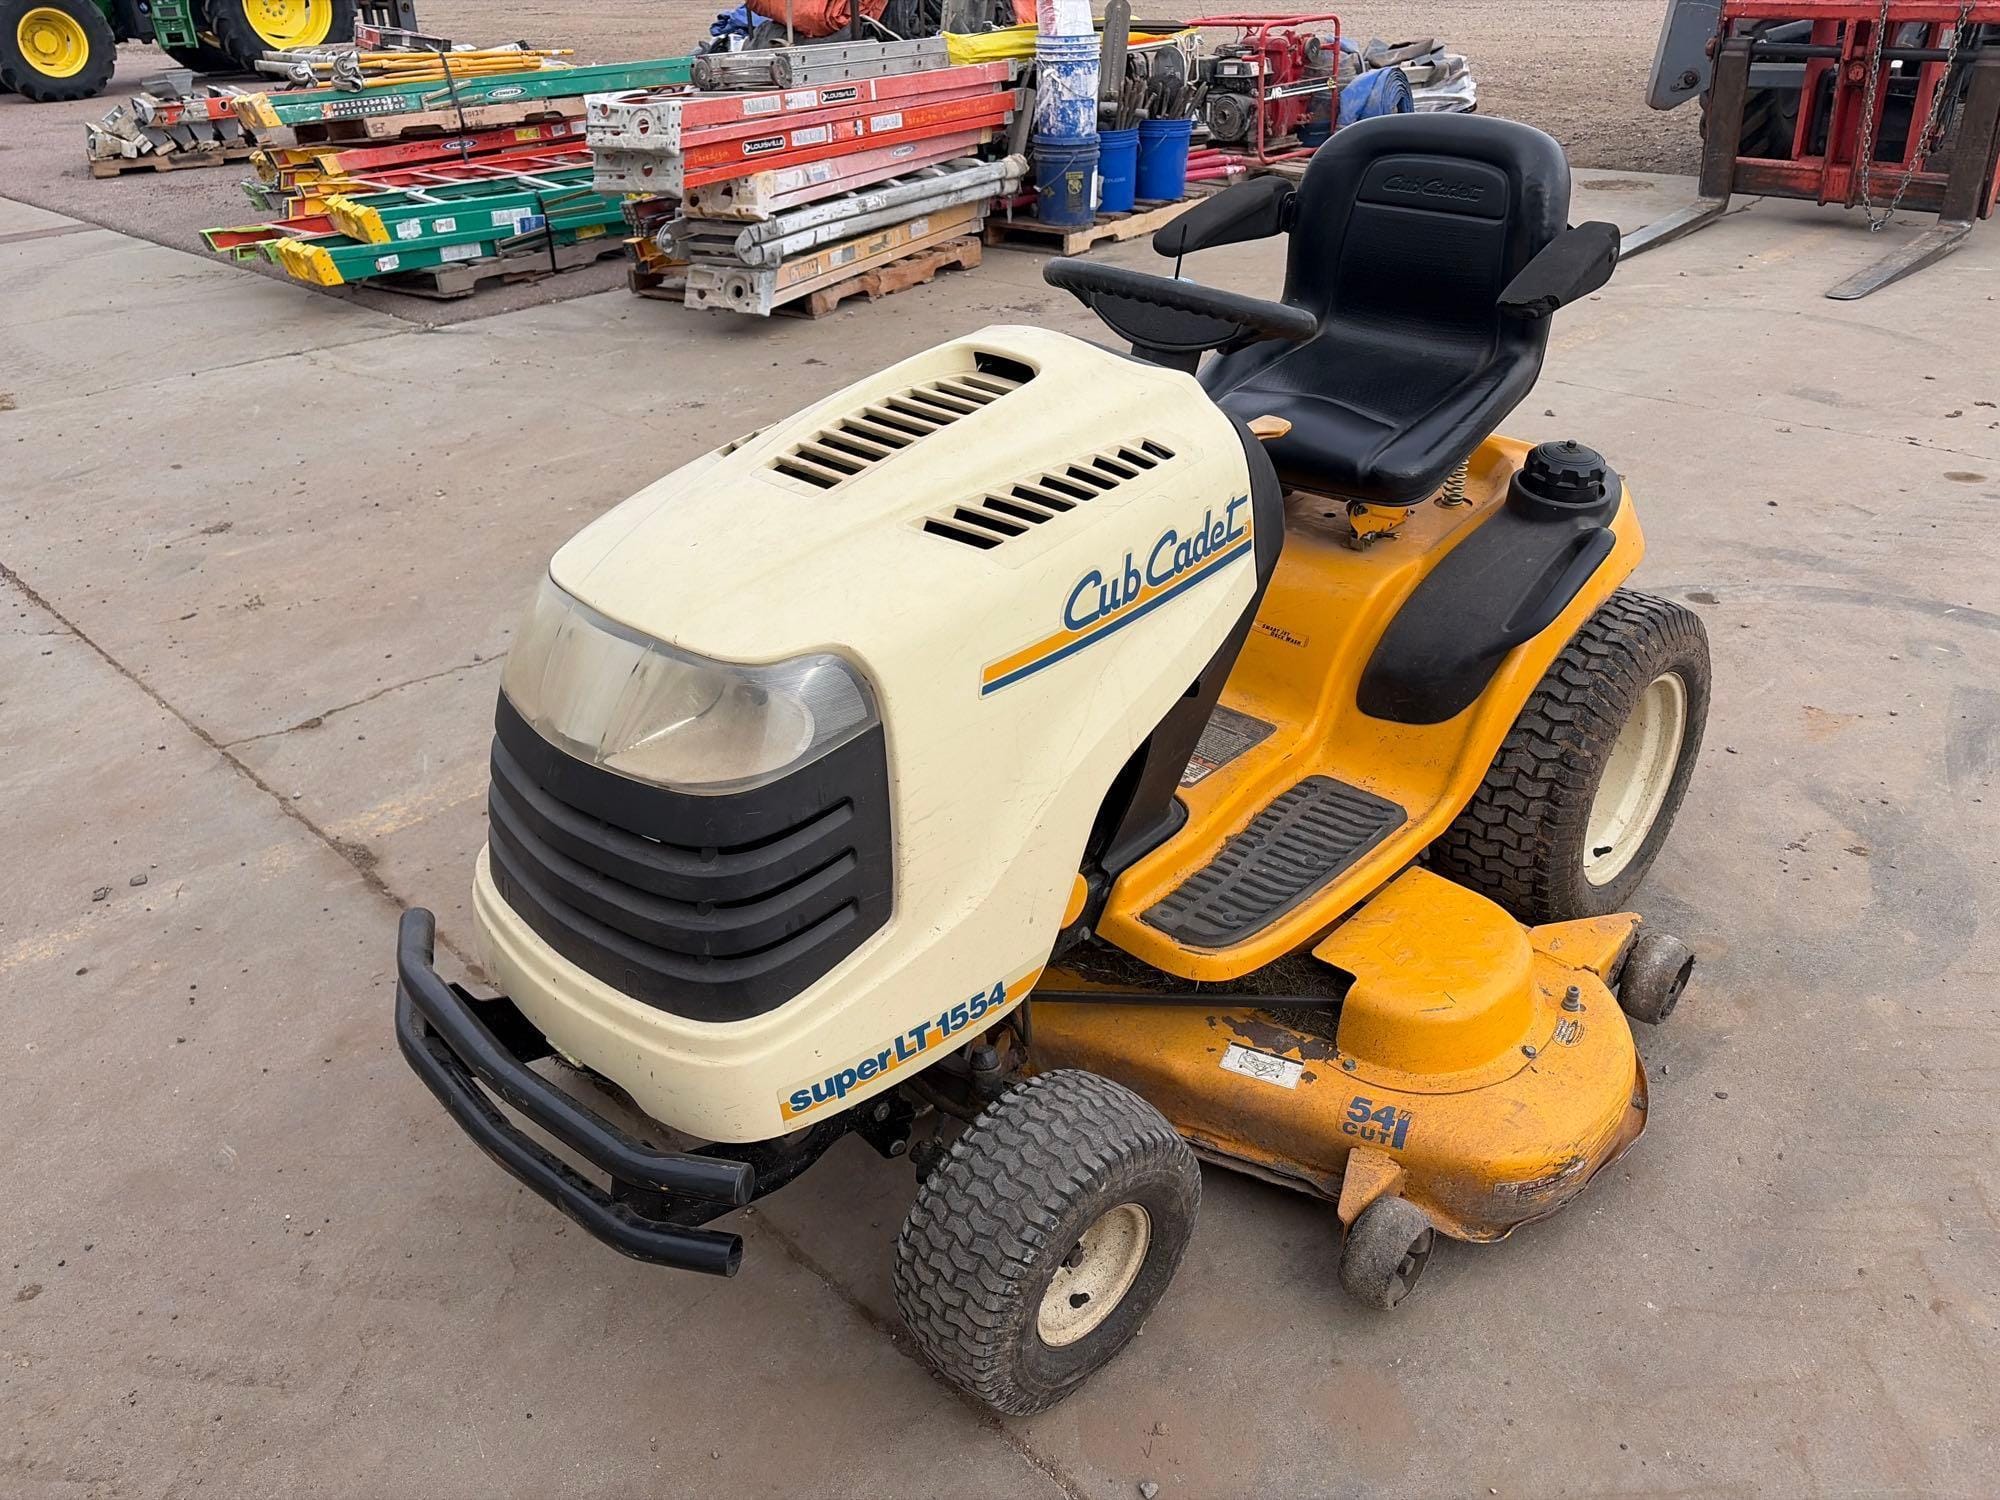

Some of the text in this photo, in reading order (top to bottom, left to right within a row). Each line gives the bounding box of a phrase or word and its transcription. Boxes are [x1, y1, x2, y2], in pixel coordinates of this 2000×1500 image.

[826, 88, 857, 100] LOUISVILLE
[750, 138, 784, 151] LOUISVILLE
[1382, 175, 1485, 202] Cub Cadet
[1064, 494, 1248, 631] Cub Cadet
[790, 981, 1006, 1112] super LT 1554
[1342, 1121, 1391, 1144] CUT
